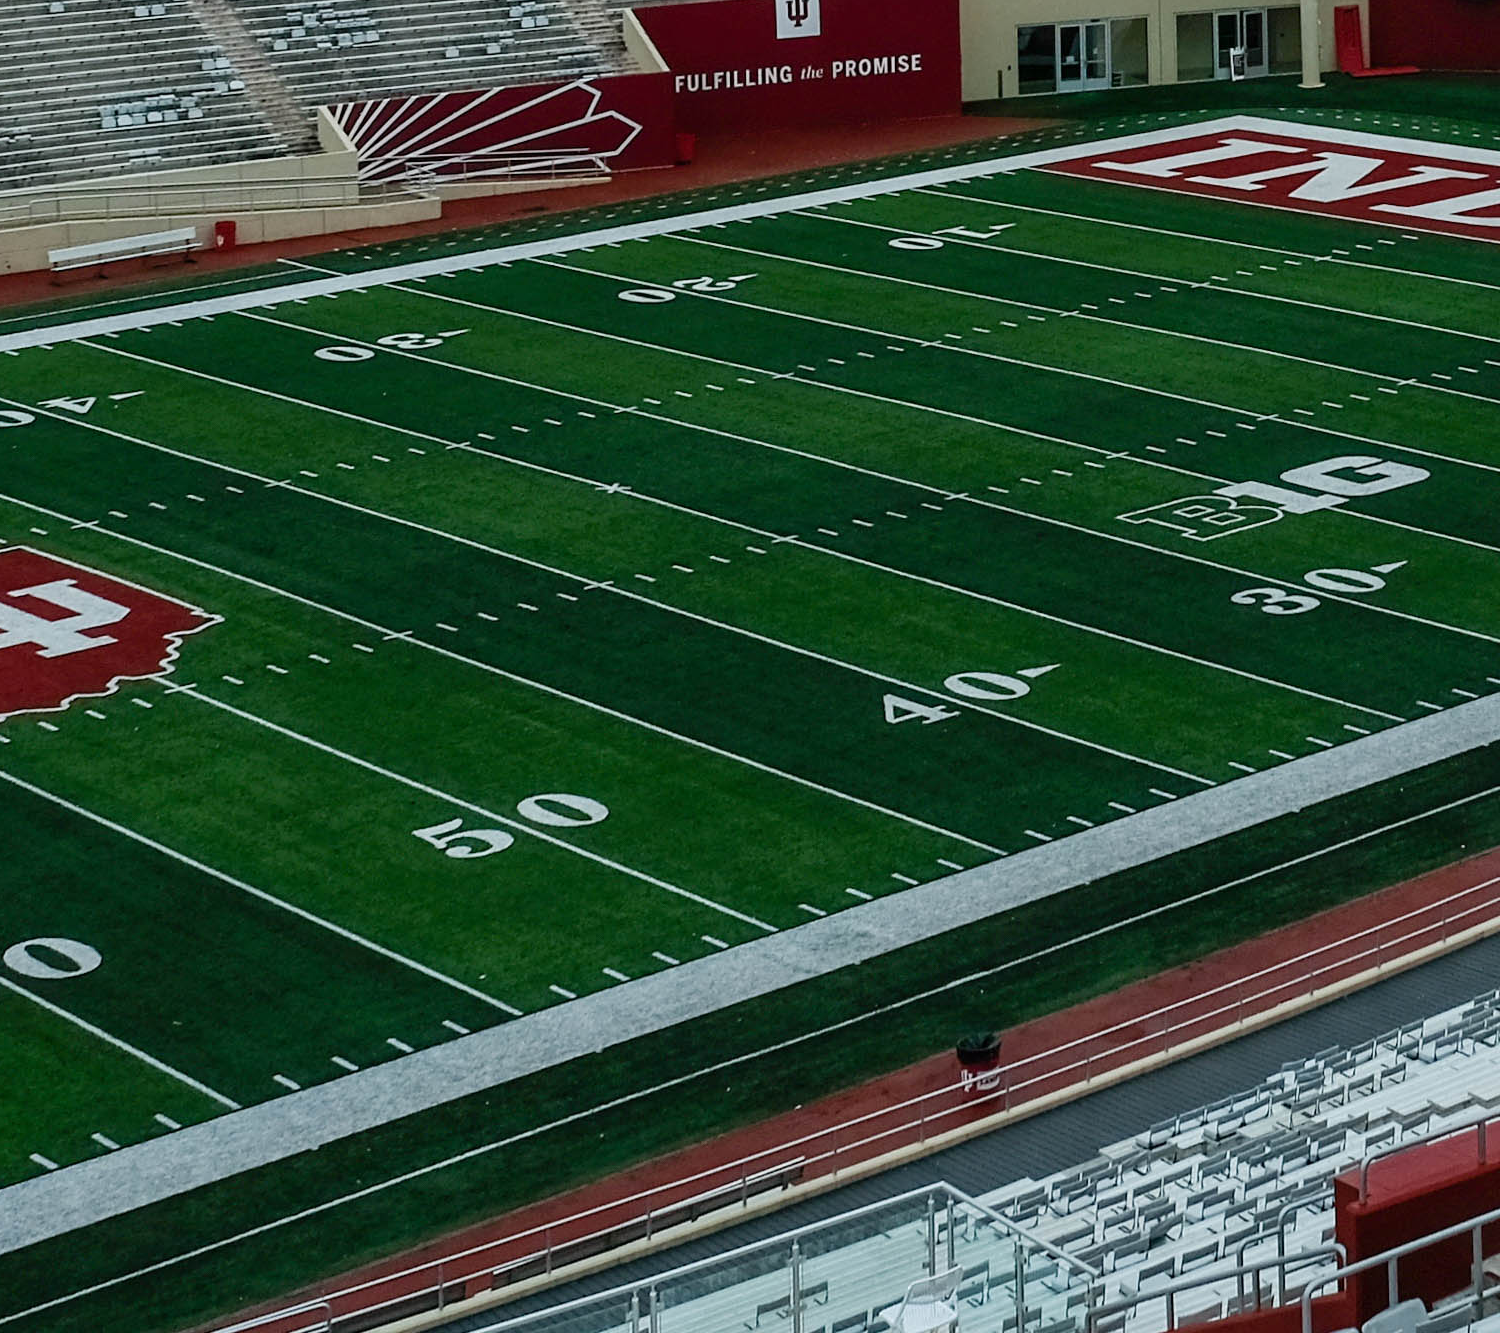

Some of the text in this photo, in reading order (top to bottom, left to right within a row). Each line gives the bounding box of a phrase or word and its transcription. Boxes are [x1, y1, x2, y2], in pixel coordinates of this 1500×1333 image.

[675, 53, 923, 94] FULFILLING the PROMISE
[888, 225, 1001, 253] 10
[617, 275, 739, 304] 20
[314, 331, 444, 363] 30
[1230, 566, 1388, 617] 30
[882, 671, 1032, 726] 40
[411, 793, 610, 860] 50
